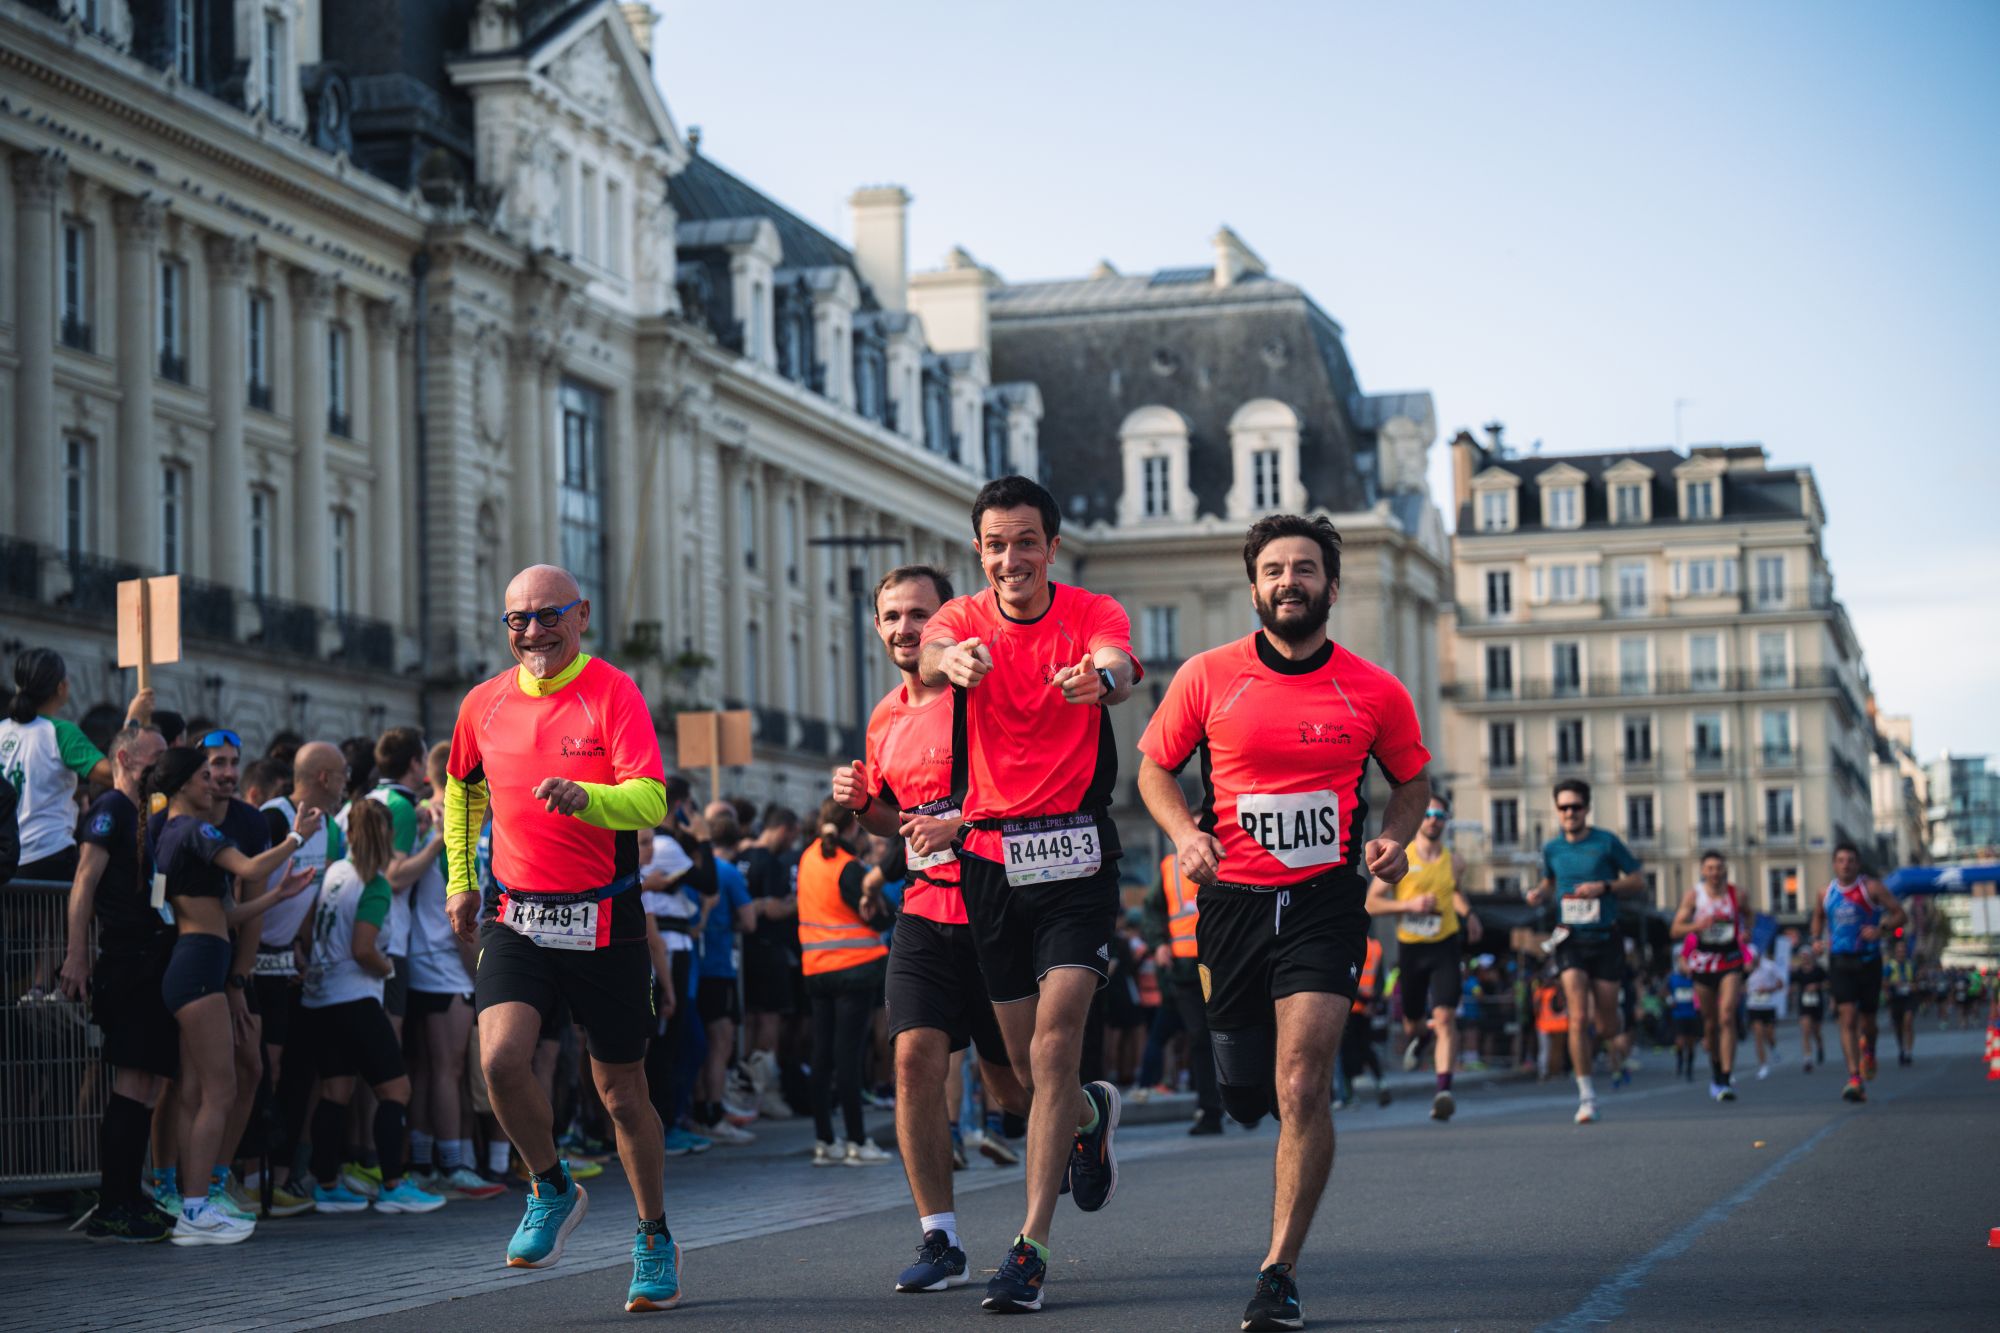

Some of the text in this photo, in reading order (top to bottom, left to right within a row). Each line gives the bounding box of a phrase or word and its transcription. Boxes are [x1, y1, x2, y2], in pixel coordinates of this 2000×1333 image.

[1075, 815, 1093, 825] 2024
[1241, 806, 1336, 850] RELAIS
[1009, 833, 1094, 865] R4449-3
[512, 905, 590, 929] R4449-1
